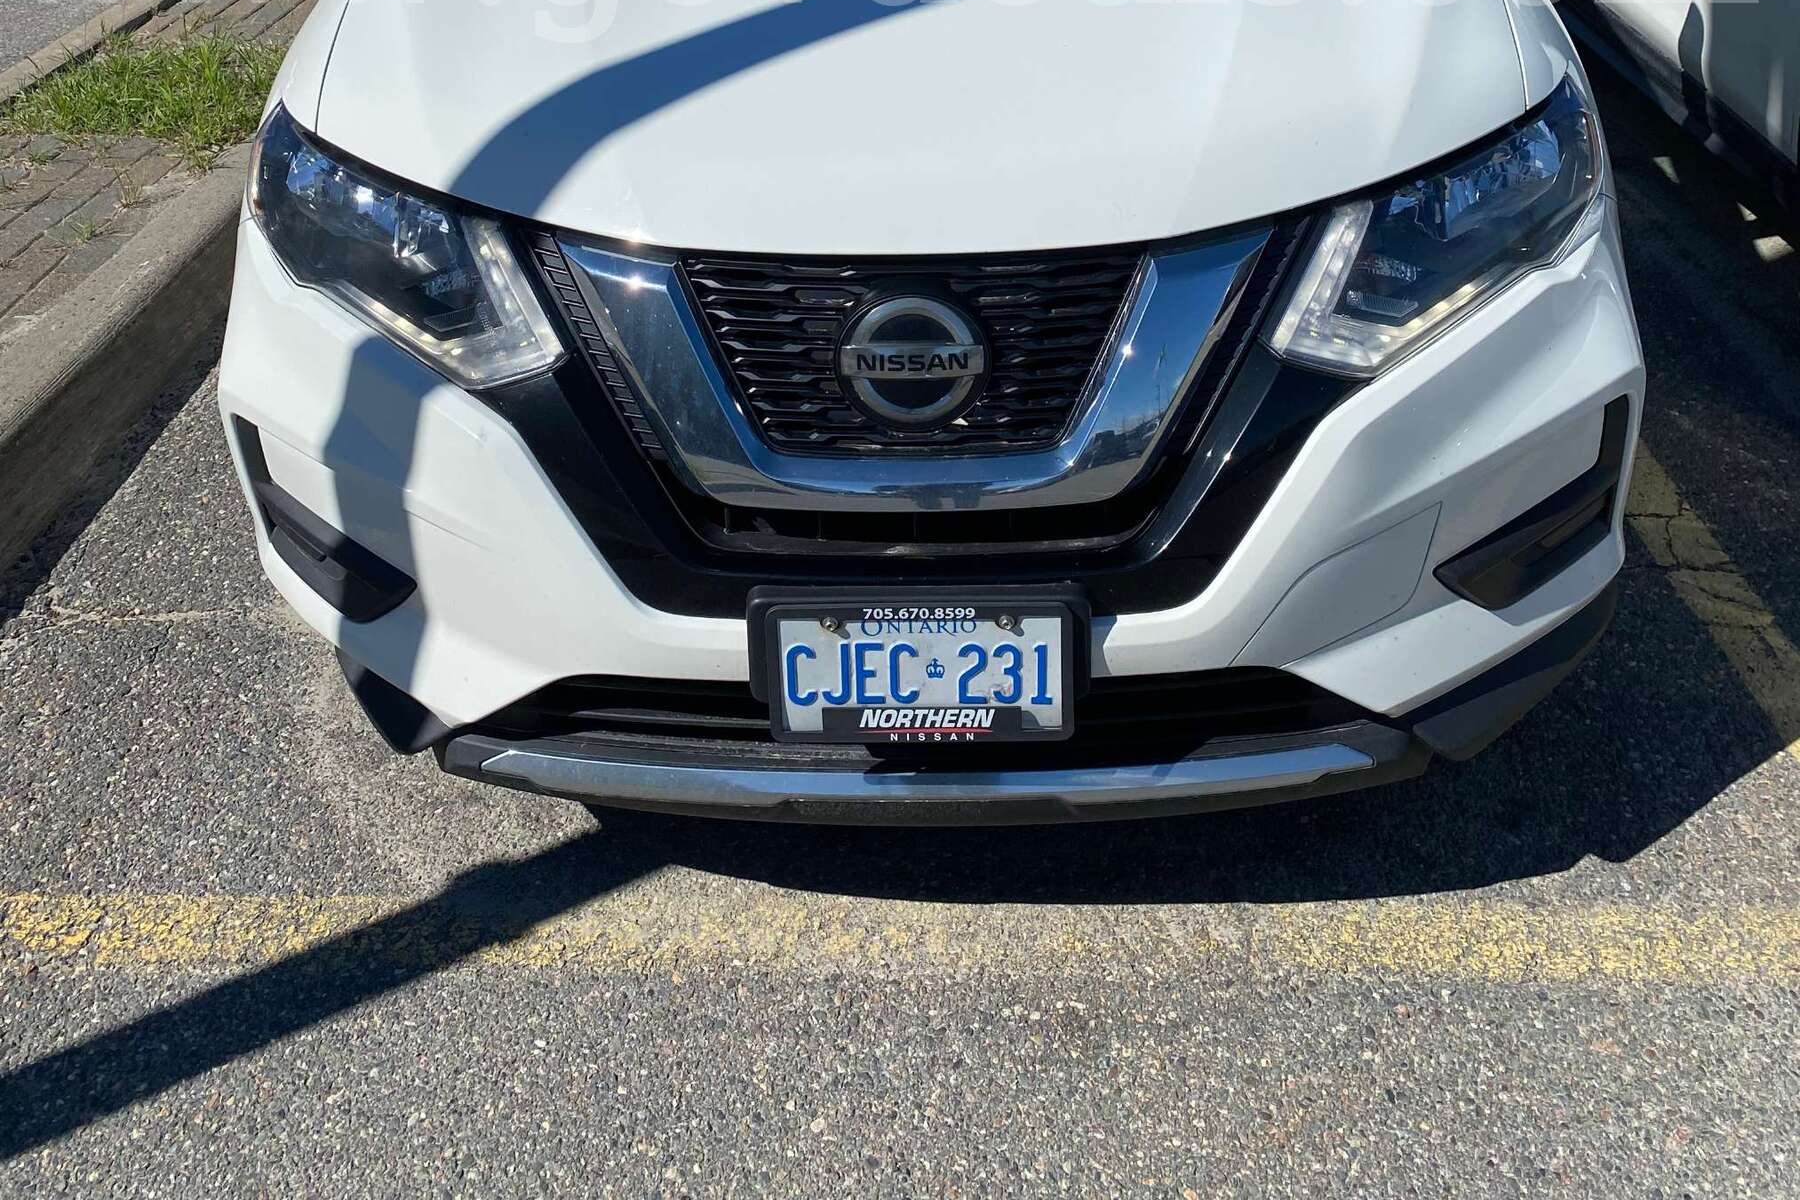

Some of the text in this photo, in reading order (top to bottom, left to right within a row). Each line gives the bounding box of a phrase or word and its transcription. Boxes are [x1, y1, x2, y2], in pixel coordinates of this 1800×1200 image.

[857, 353, 968, 371] NISSAN
[863, 608, 976, 620] 705.670.8599
[861, 619, 977, 637] ONTARIO
[786, 643, 1053, 705] CJEC 231
[859, 709, 995, 727] NORTHERN
[890, 733, 975, 741] NISSAN
